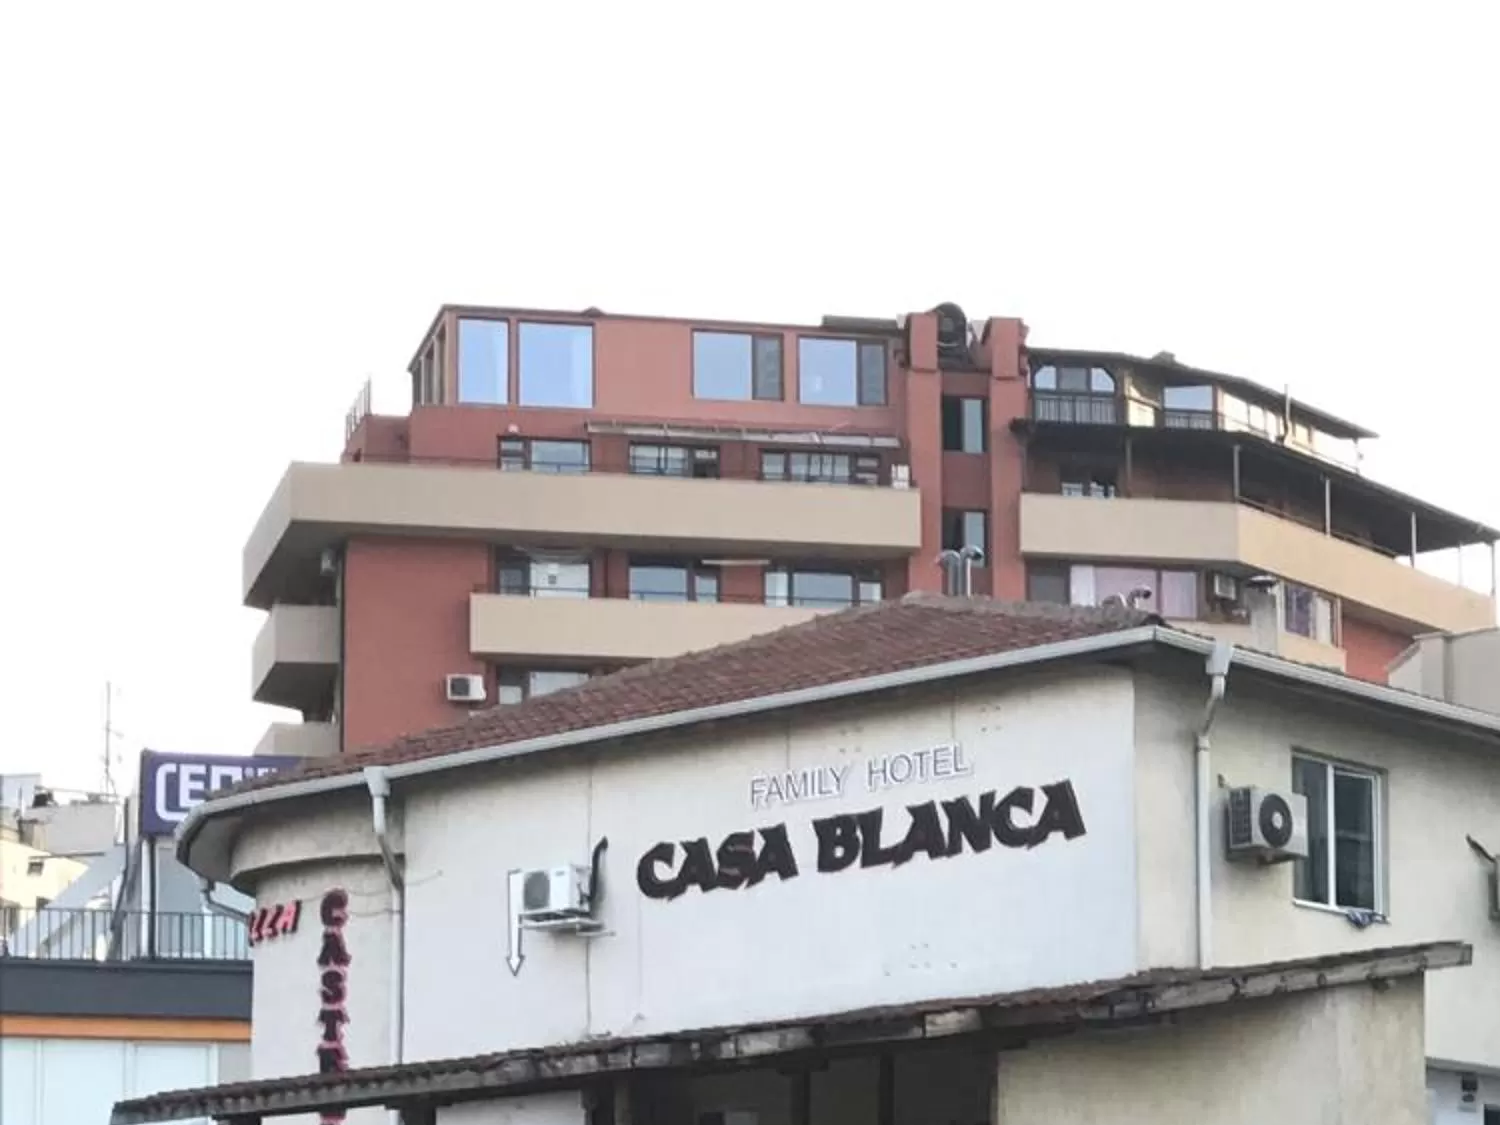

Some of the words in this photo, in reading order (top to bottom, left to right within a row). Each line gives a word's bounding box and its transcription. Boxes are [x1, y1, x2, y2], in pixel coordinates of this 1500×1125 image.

[750, 763, 849, 808] FAMILY
[867, 744, 969, 786] HOTEL
[637, 822, 799, 900] CASA
[813, 779, 1087, 873] BLANCA
